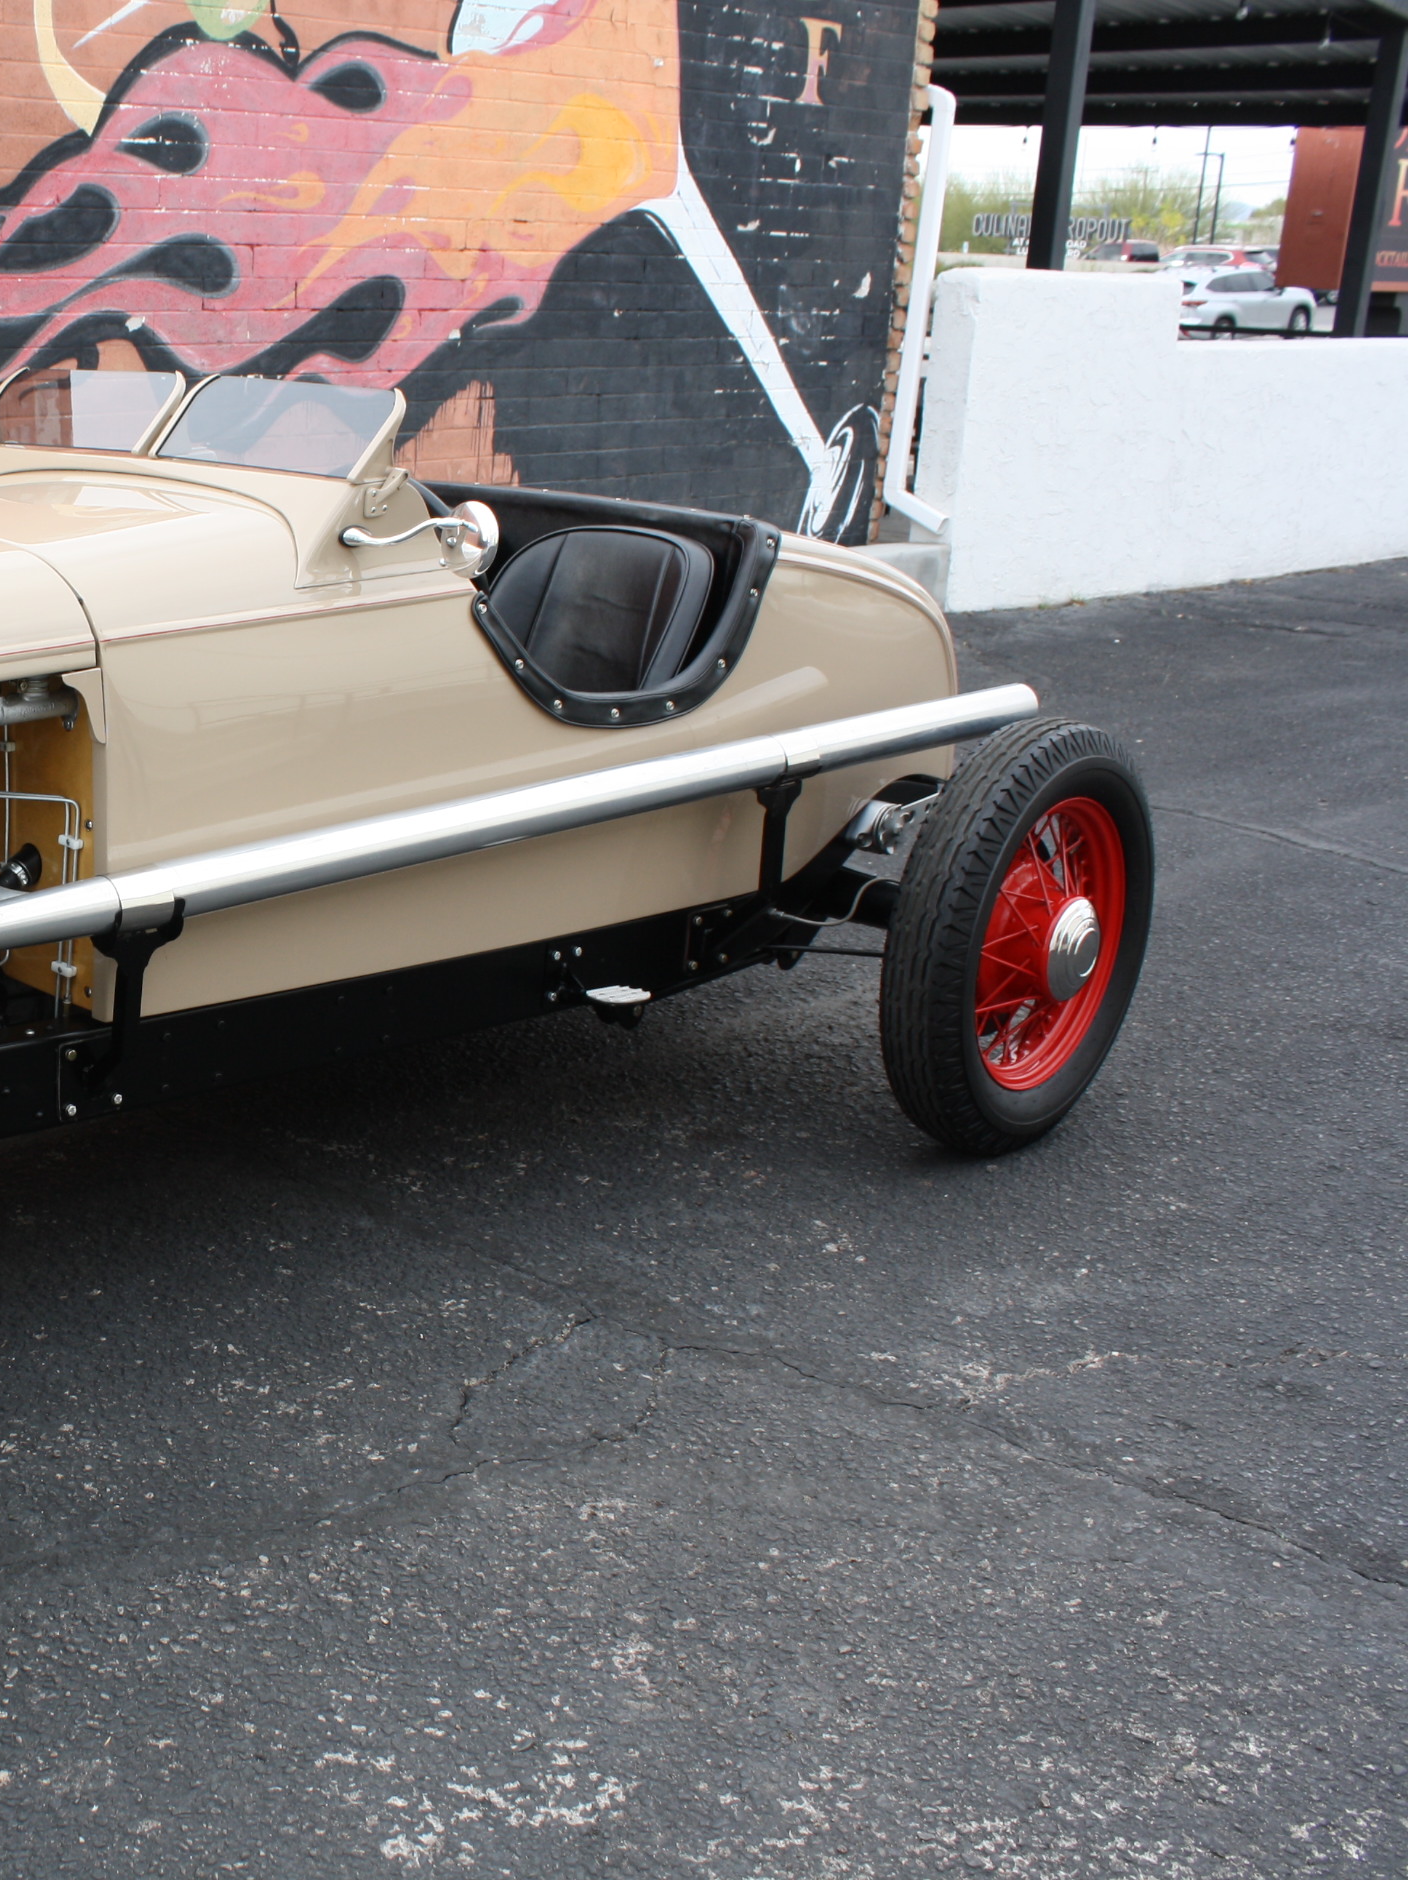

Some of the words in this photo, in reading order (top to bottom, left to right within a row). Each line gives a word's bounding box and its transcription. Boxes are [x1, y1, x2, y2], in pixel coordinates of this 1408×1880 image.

[795, 16, 842, 107] F
[973, 213, 1031, 238] CULINA
[1067, 216, 1130, 242] ROPOUT
[1065, 239, 1087, 248] OAD
